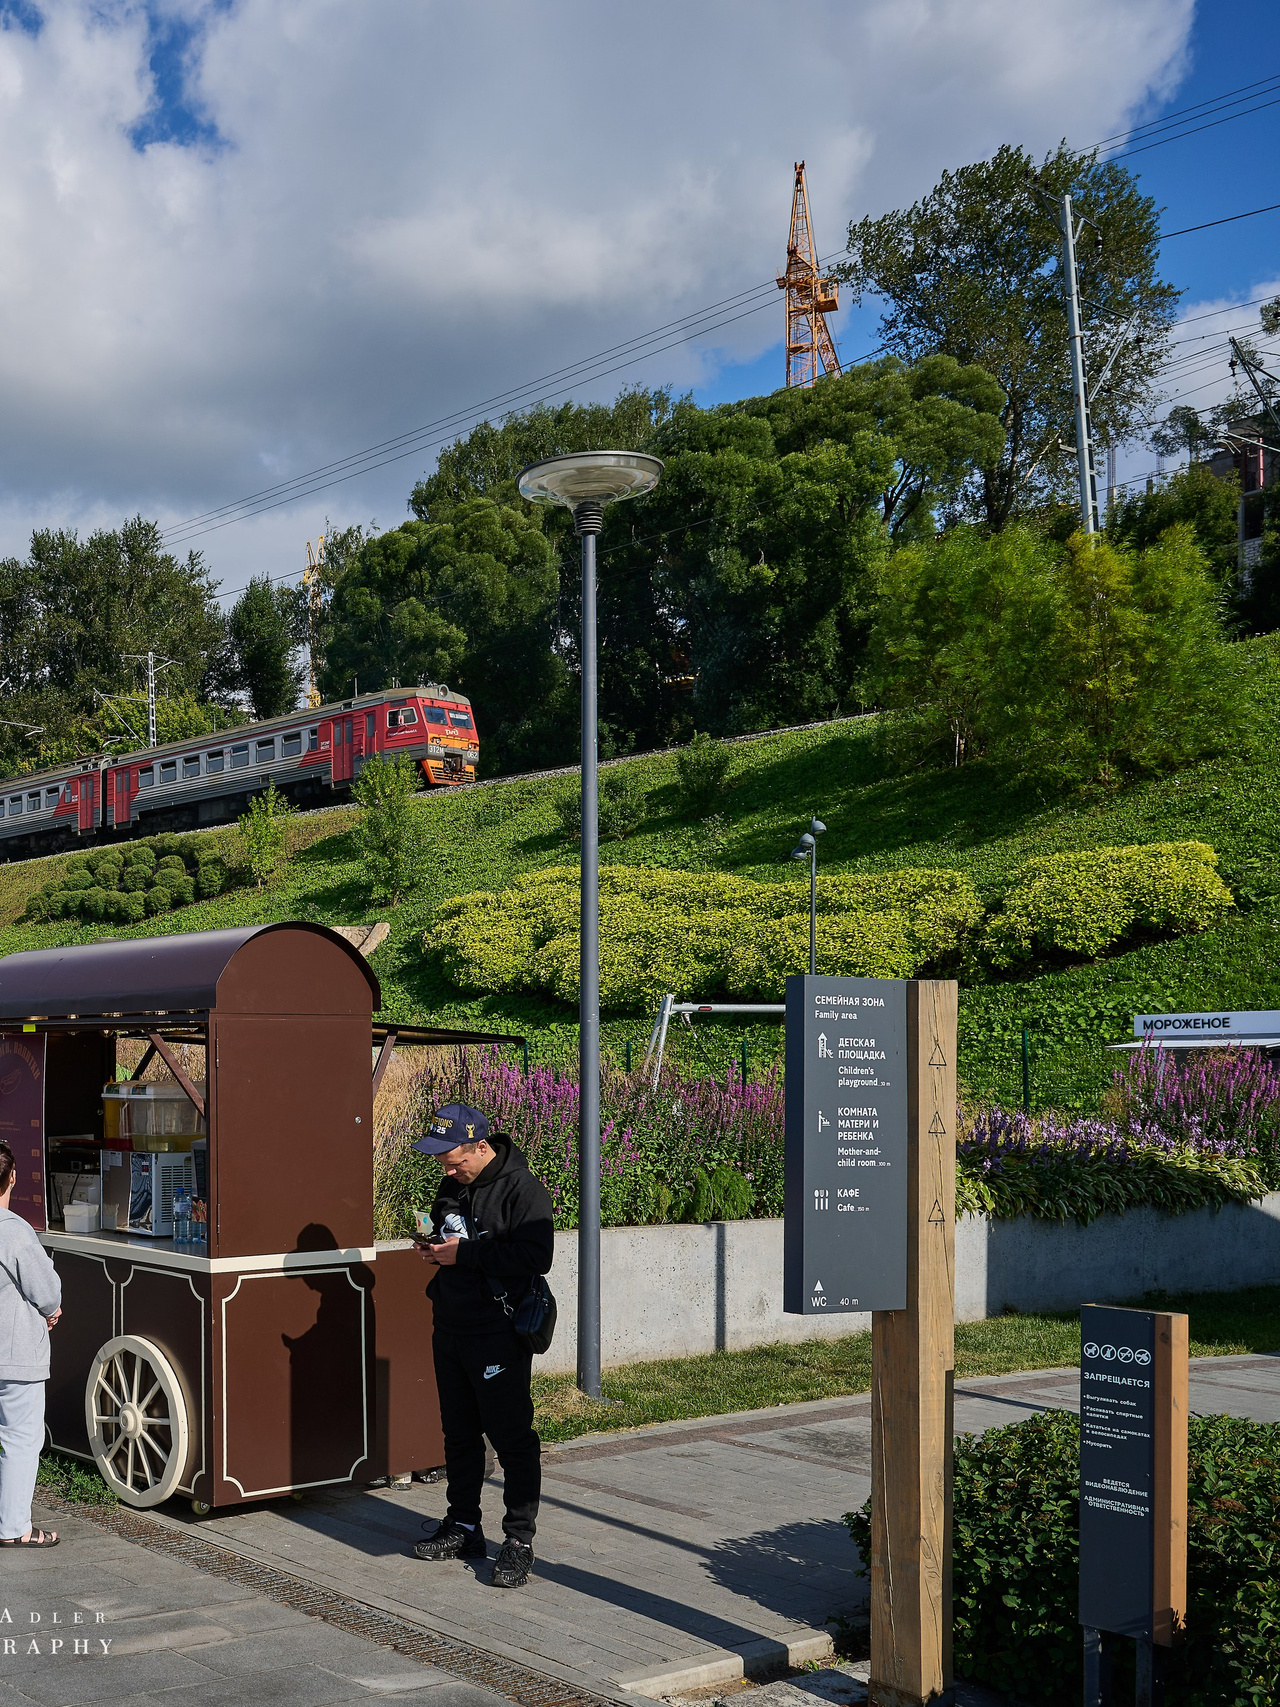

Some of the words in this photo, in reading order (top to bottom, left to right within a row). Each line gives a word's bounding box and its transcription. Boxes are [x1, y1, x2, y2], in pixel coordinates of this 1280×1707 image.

[815, 994, 860, 1006] СЕМЕЙНАЯ
[862, 998, 885, 1007] ЗОНА
[815, 1010, 839, 1021] Family
[841, 1012, 858, 1020] area
[1143, 1017, 1231, 1030] МОРОЖЕНОЕ
[838, 1038, 875, 1047] ДЕТСКАЯ
[838, 1050, 886, 1061] ПЛОЩАДКА
[838, 1066, 875, 1075] Children's
[838, 1077, 878, 1088] playground
[838, 1108, 878, 1117] КОМНАТА
[838, 1120, 870, 1129] МАТЕРИ
[873, 1120, 879, 1129] И
[838, 1132, 874, 1141] РЕБЕНКА
[838, 1147, 882, 1156] Mother-and-
[837, 1158, 856, 1166] child
[837, 1188, 860, 1198] КАФЕ
[837, 1203, 855, 1212] Cafe
[811, 1296, 827, 1307] WC
[840, 1298, 849, 1306] 40
[485, 1364, 500, 1373] NIKE
[1084, 1372, 1150, 1389] ЗАПРЕЩАЕТСЯ
[1086, 1422, 1111, 1431] Кататься
[1120, 1429, 1150, 1438] самокатах
[1086, 1440, 1112, 1449] Мусорить
[1103, 1478, 1130, 1488] ВЕДЕТСЯ
[1085, 1480, 1148, 1498] ВИДЕОНАБЛЮДЕНИЕ
[1084, 1495, 1150, 1513] АДМИНИСТРАТИВНАЯ
[1088, 1501, 1145, 1517] ОТВЕТСТВЕННОСТЬ
